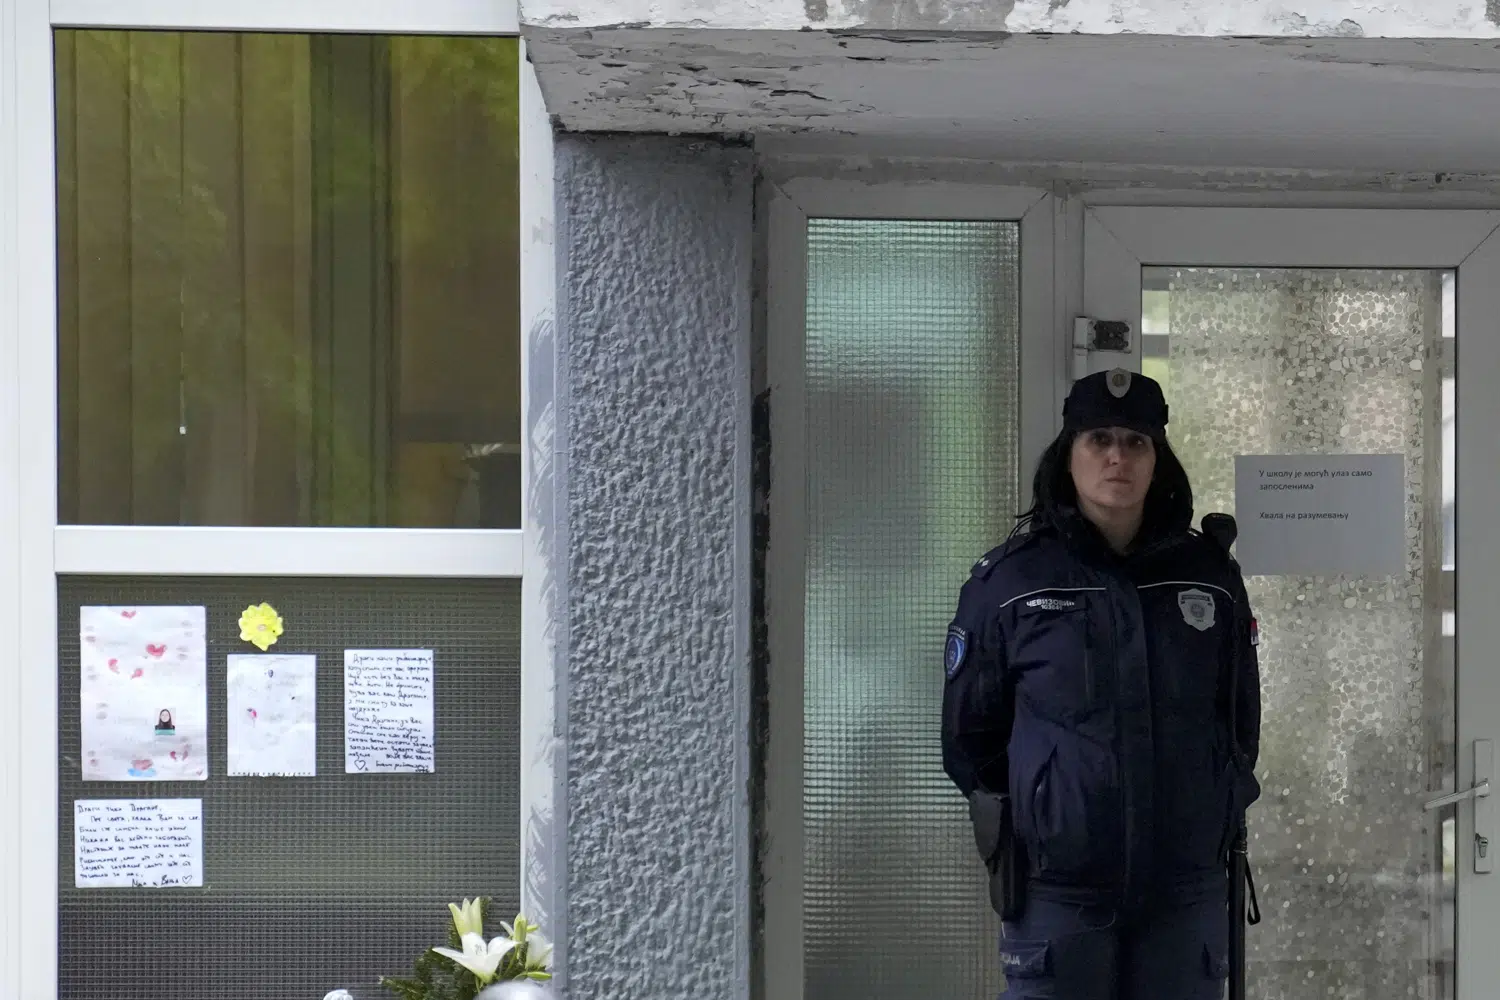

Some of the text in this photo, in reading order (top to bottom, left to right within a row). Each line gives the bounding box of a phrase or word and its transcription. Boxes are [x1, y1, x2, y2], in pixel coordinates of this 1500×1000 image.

[1293, 470, 1302, 478] је
[1304, 469, 1329, 478] могућ
[1297, 512, 1349, 520] разумевању
